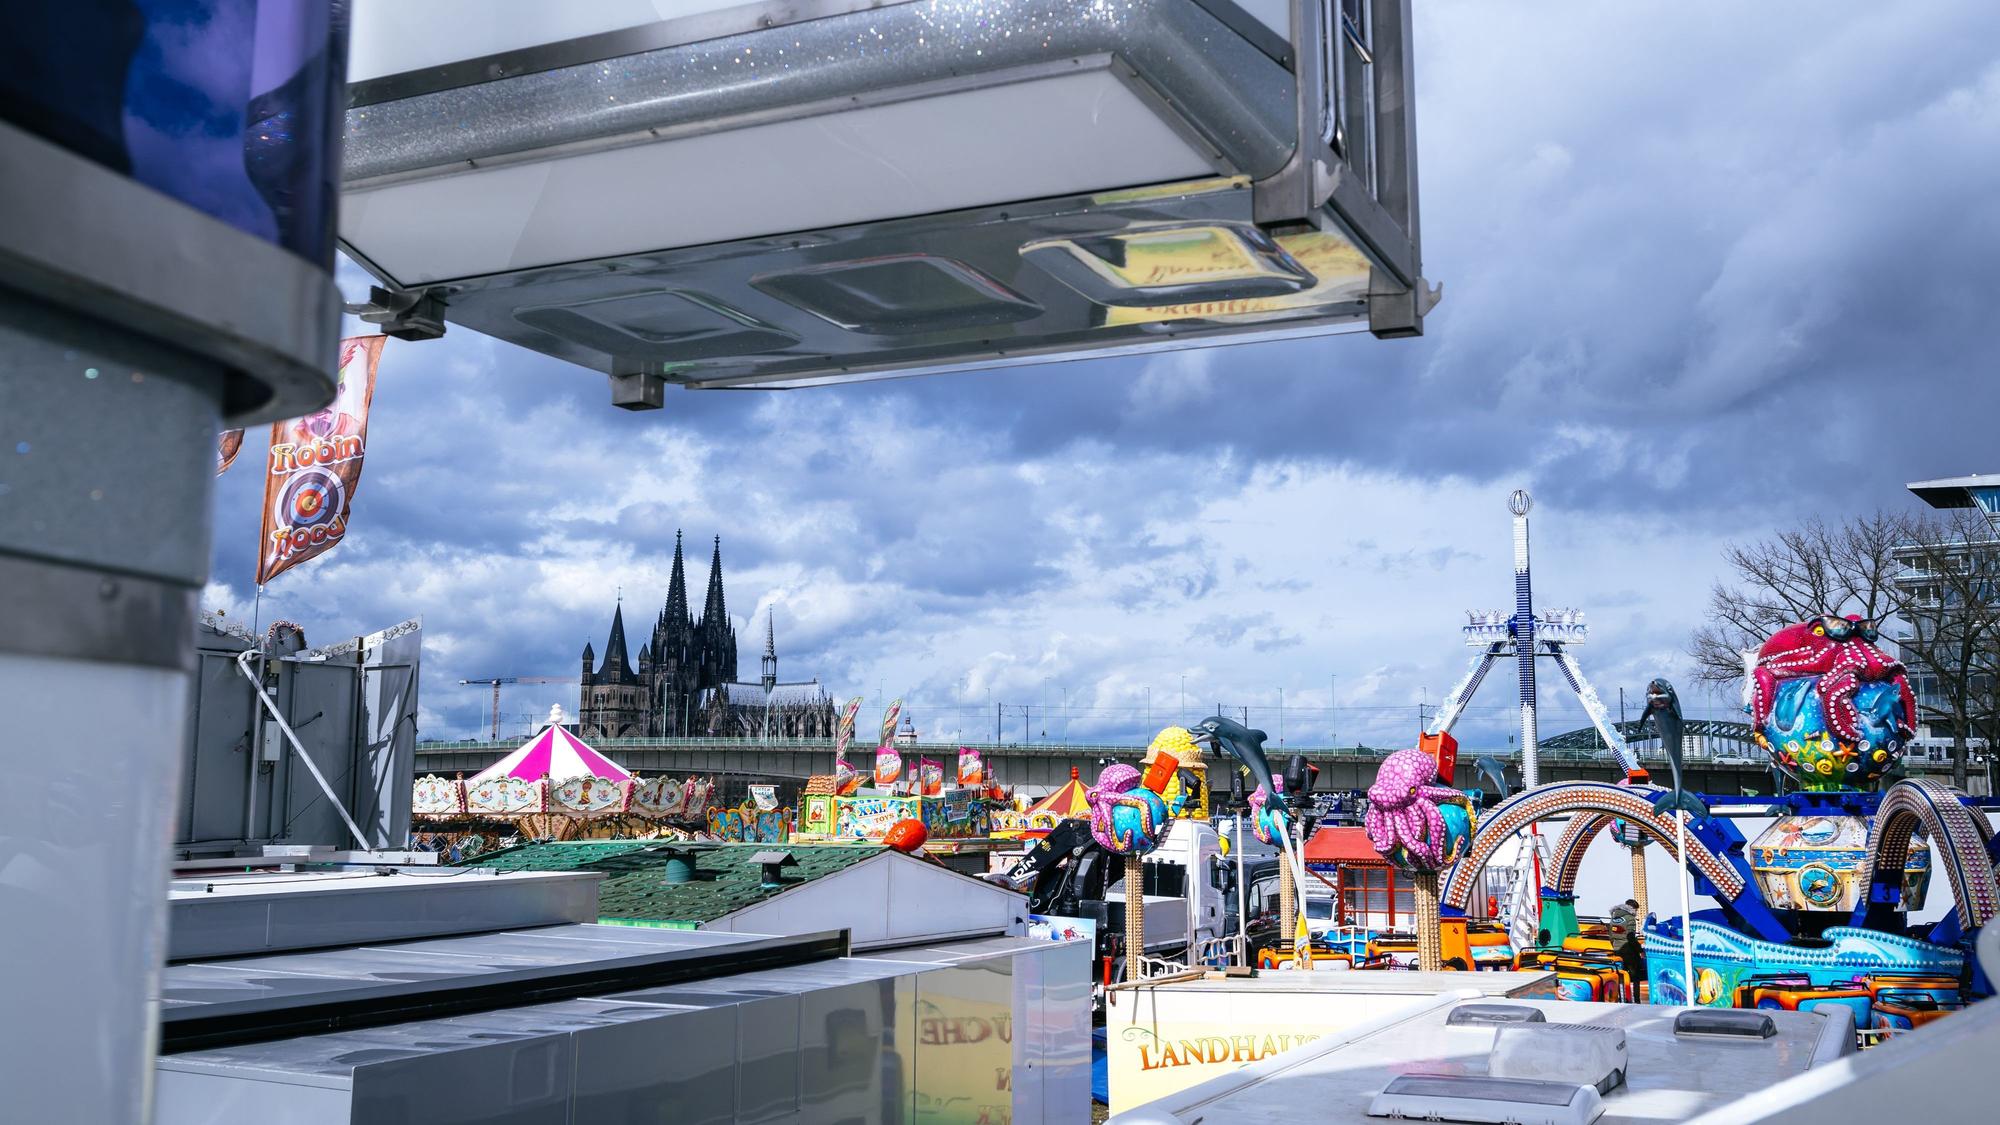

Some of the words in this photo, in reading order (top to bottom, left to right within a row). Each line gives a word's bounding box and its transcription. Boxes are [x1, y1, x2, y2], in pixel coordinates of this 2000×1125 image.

[272, 436, 364, 473] Robin
[1463, 624, 1505, 643] THE
[1535, 624, 1587, 641] KING
[858, 803, 886, 817] XXL
[874, 813, 895, 824] TOYS
